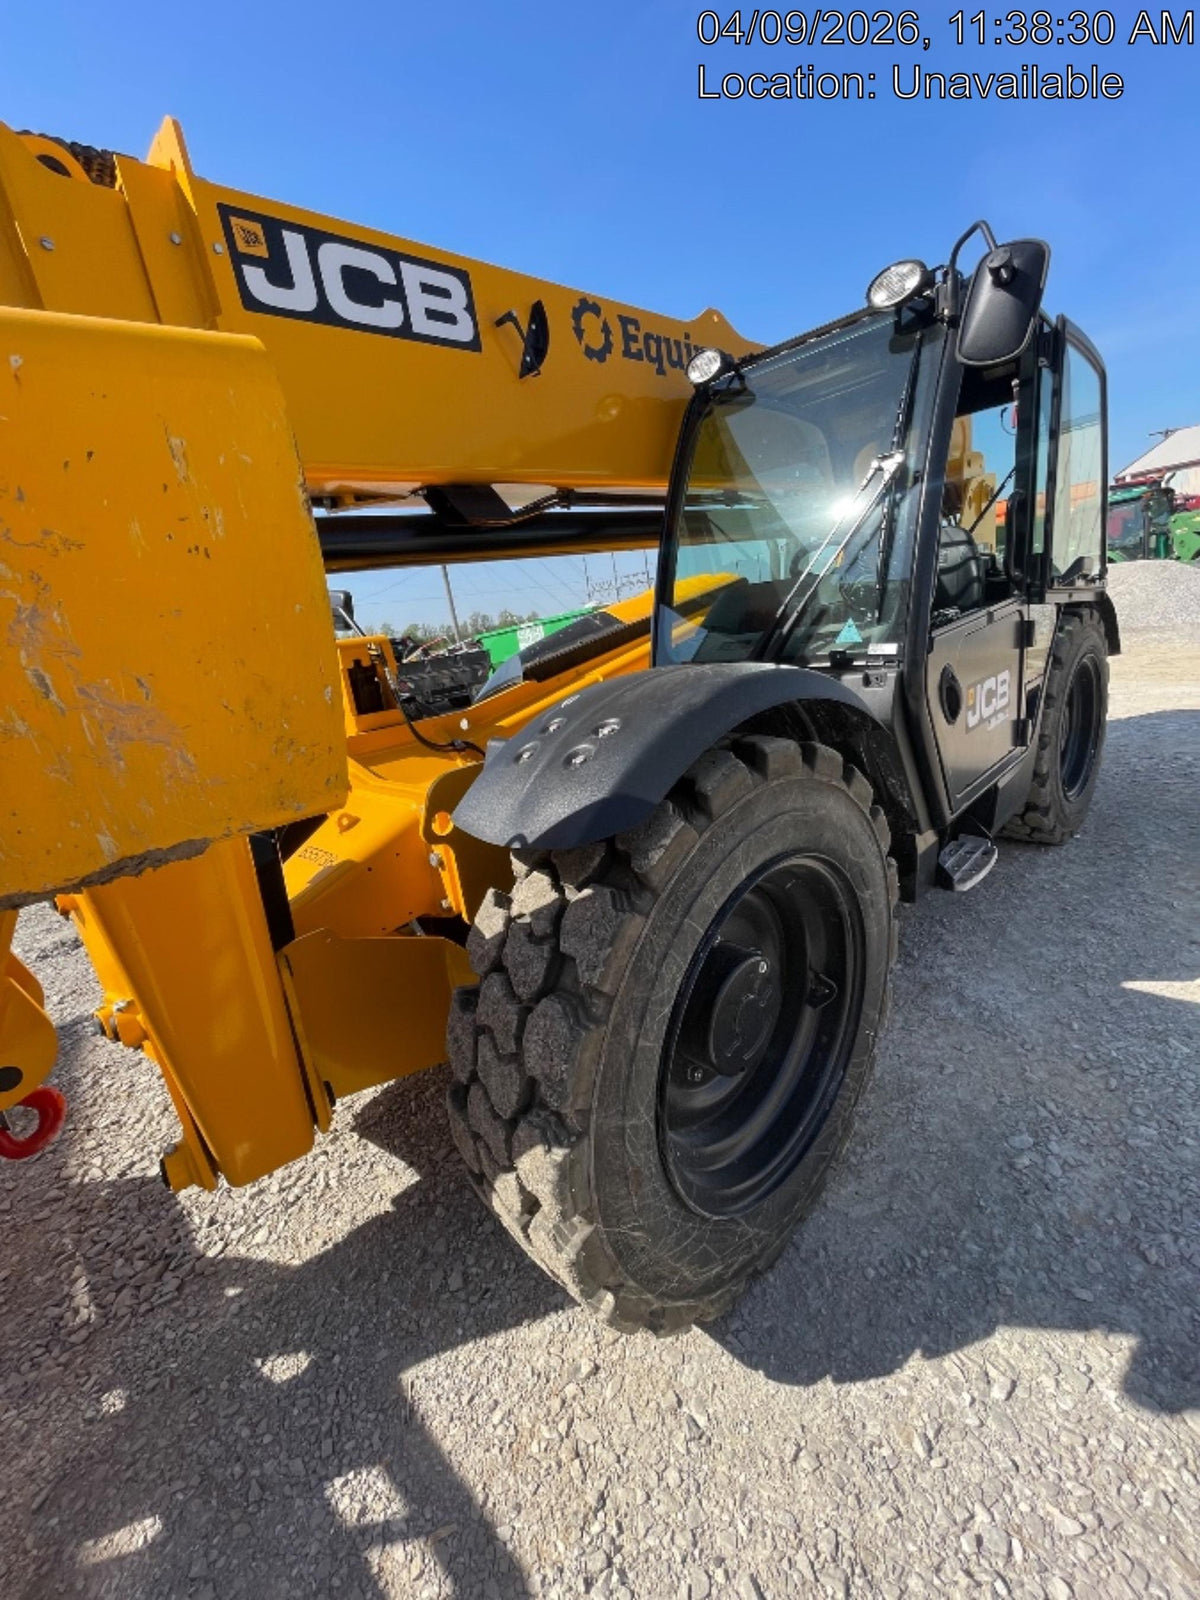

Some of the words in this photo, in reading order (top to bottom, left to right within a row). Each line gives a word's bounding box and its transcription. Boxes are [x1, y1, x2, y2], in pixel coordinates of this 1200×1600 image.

[241, 229, 475, 343] JCB
[617, 314, 704, 376] Equi
[967, 669, 1010, 728] JCB
